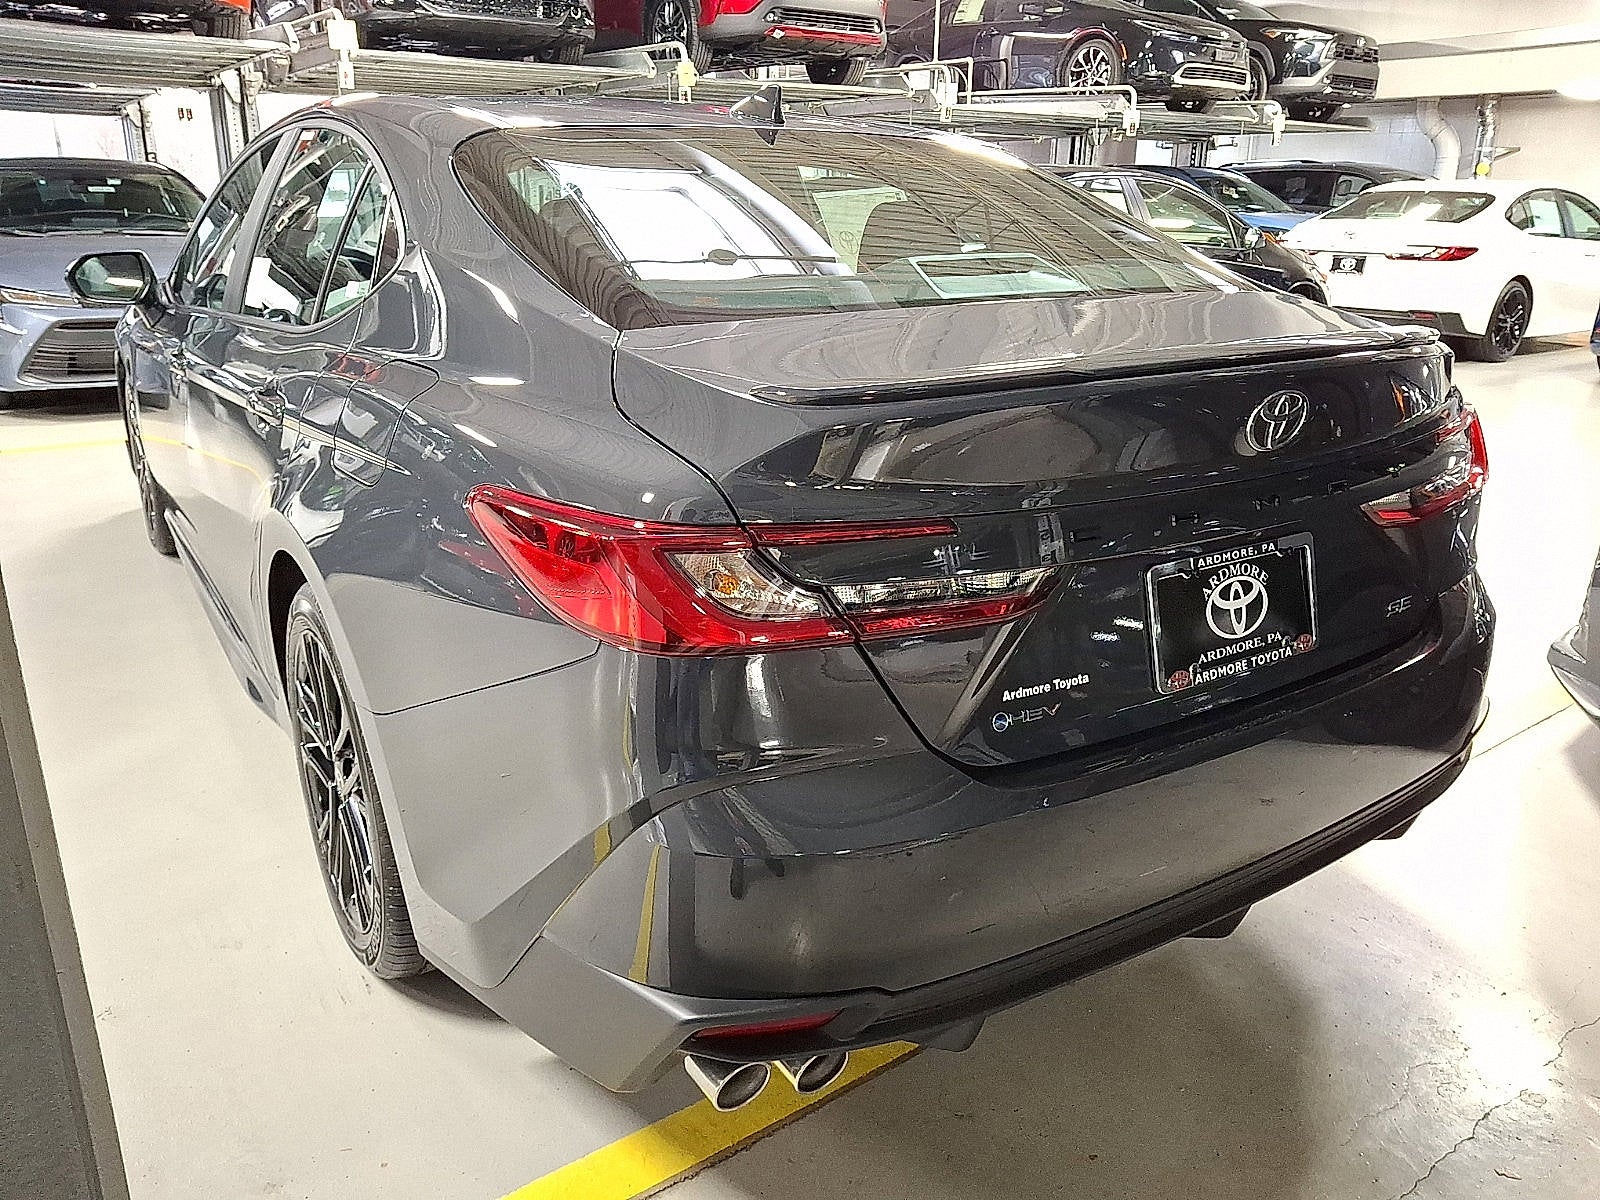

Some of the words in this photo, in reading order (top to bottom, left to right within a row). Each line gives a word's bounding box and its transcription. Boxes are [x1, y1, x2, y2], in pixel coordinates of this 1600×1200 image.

[1198, 547, 1258, 568] ARDMORE,
[1262, 542, 1276, 553] PA
[1202, 563, 1269, 601] ARDMORE
[1198, 637, 1265, 665] ARDMORE,
[1267, 631, 1283, 643] PA
[1194, 659, 1249, 686] ARDMORE
[1250, 646, 1293, 668] TOYOTA
[1002, 683, 1051, 702] Ardmore
[1052, 673, 1090, 690] Toyota
